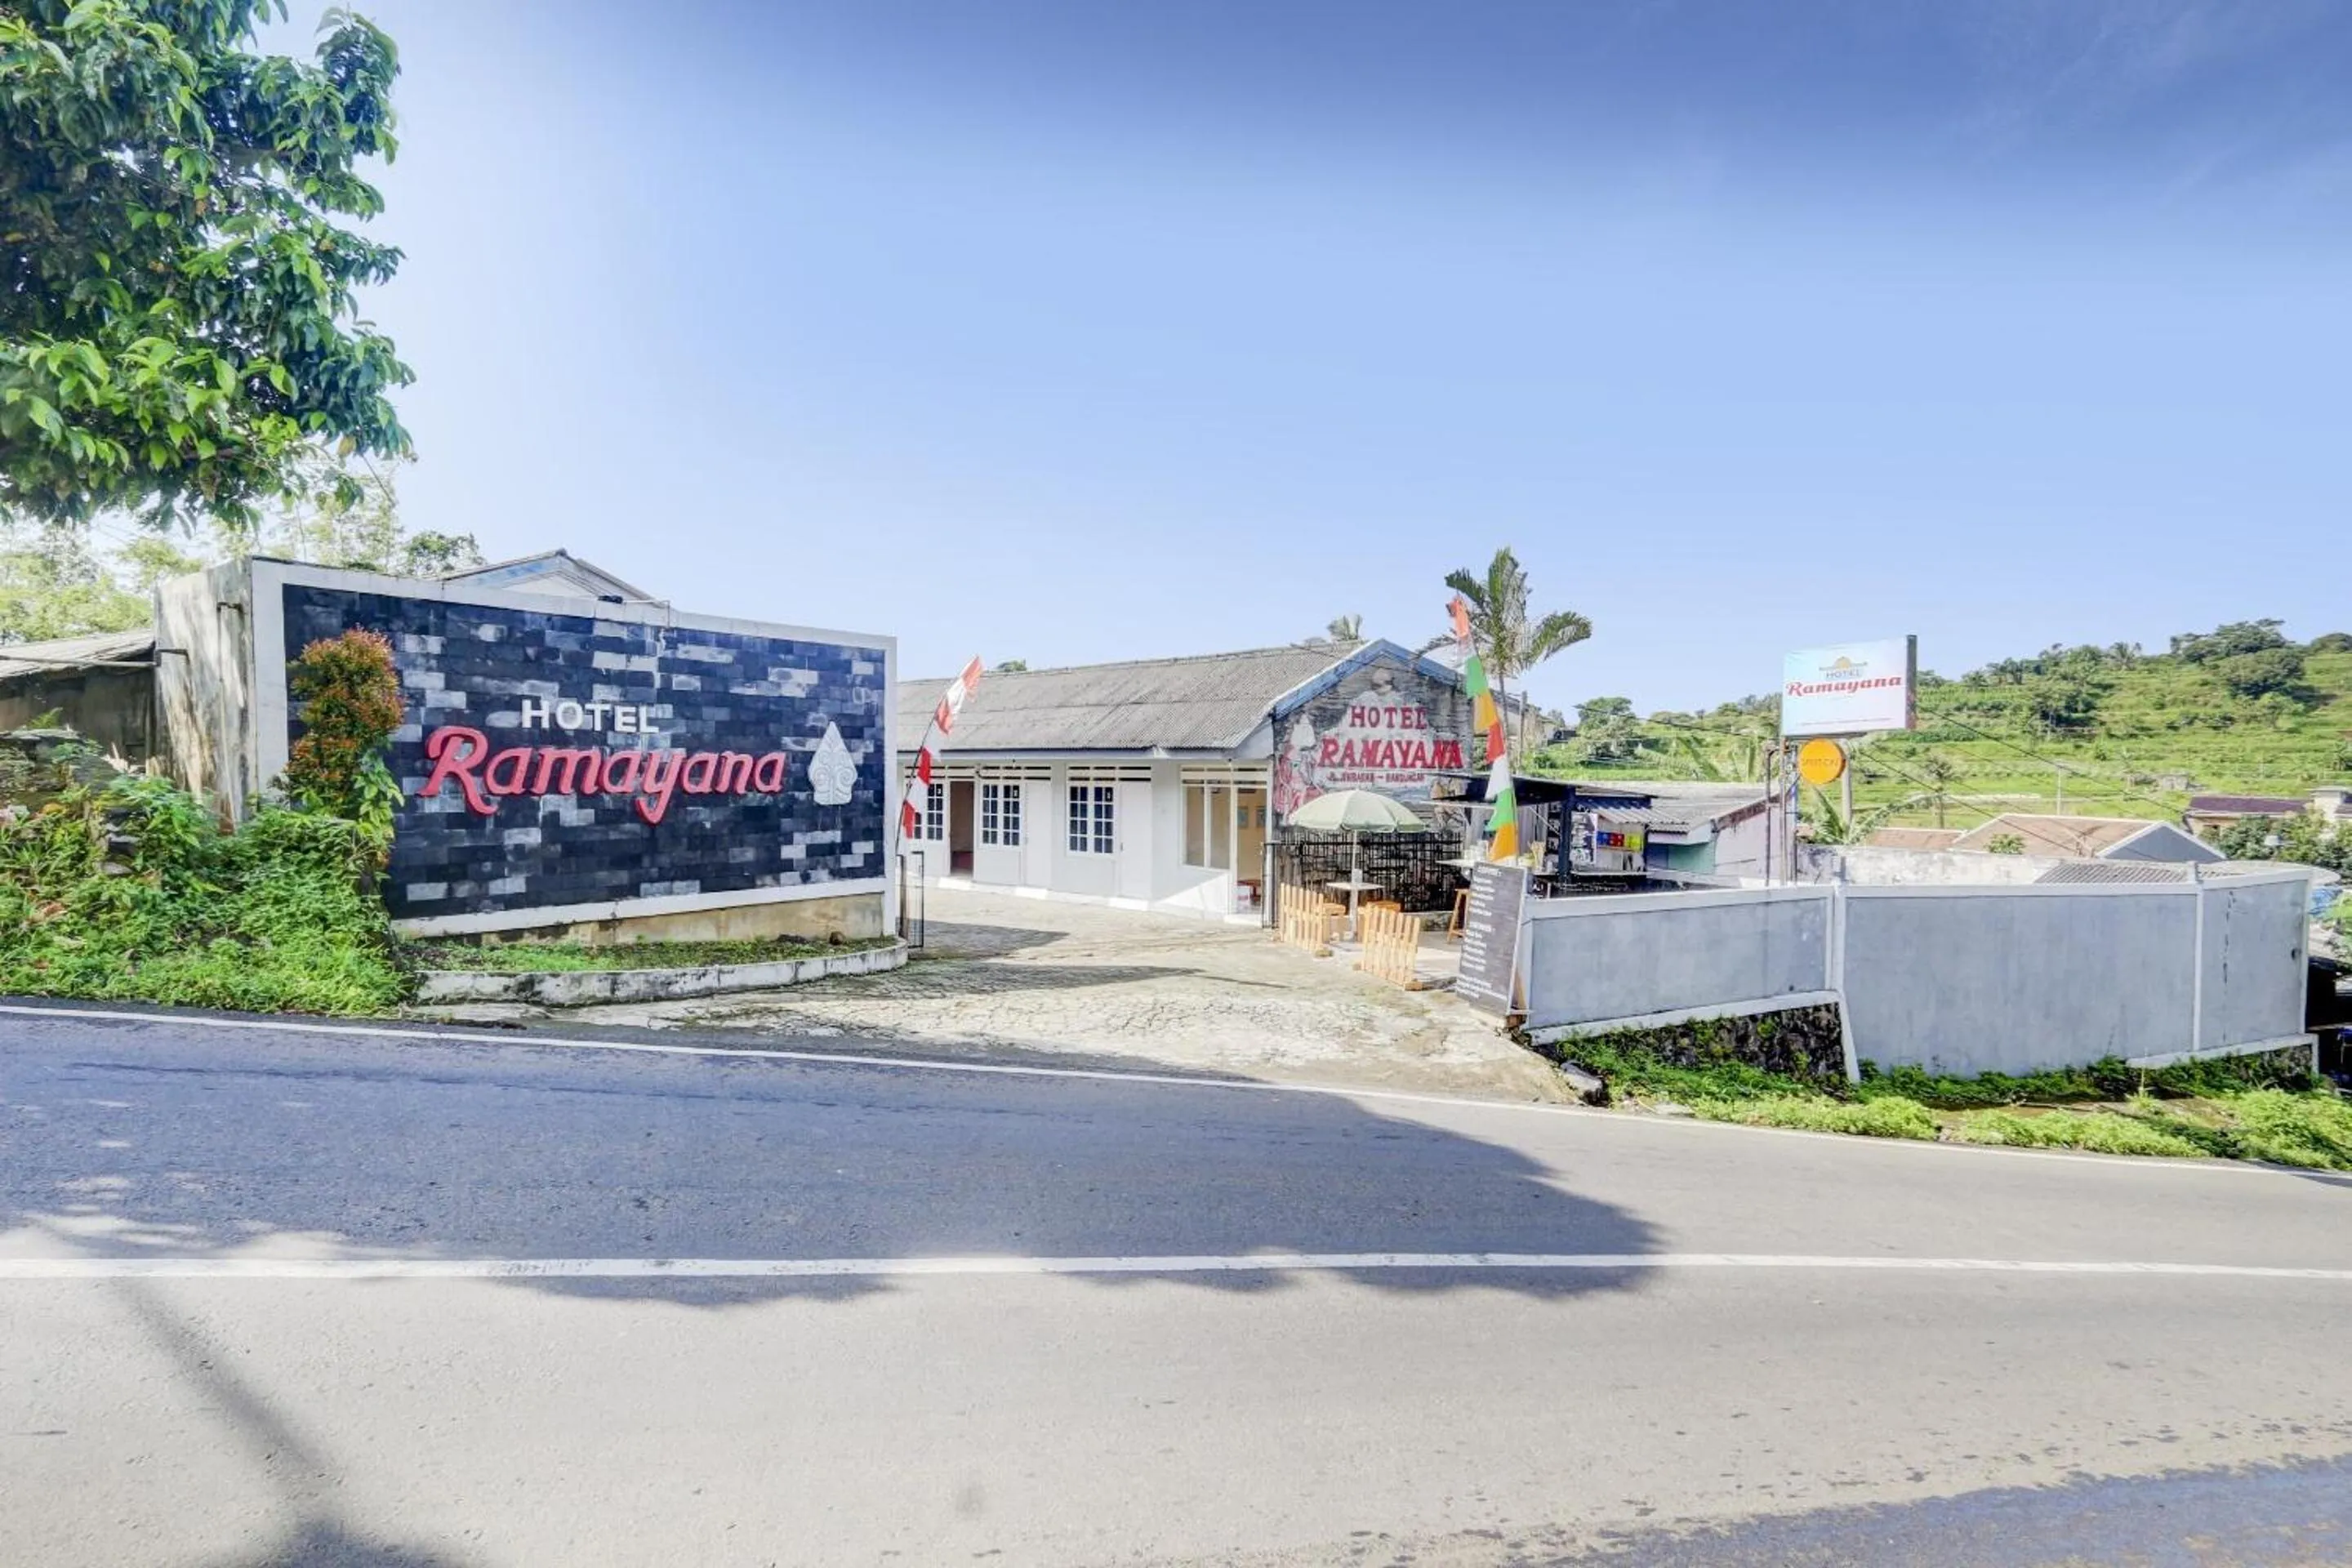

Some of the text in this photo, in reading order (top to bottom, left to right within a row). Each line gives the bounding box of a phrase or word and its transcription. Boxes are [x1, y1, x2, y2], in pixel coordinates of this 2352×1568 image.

[1786, 677, 1902, 697] Ramayana
[521, 699, 659, 733] HOTEL
[1349, 706, 1428, 730] HOTEL
[1317, 738, 1463, 769] RAMAYANA
[416, 725, 786, 825] Ramayana
